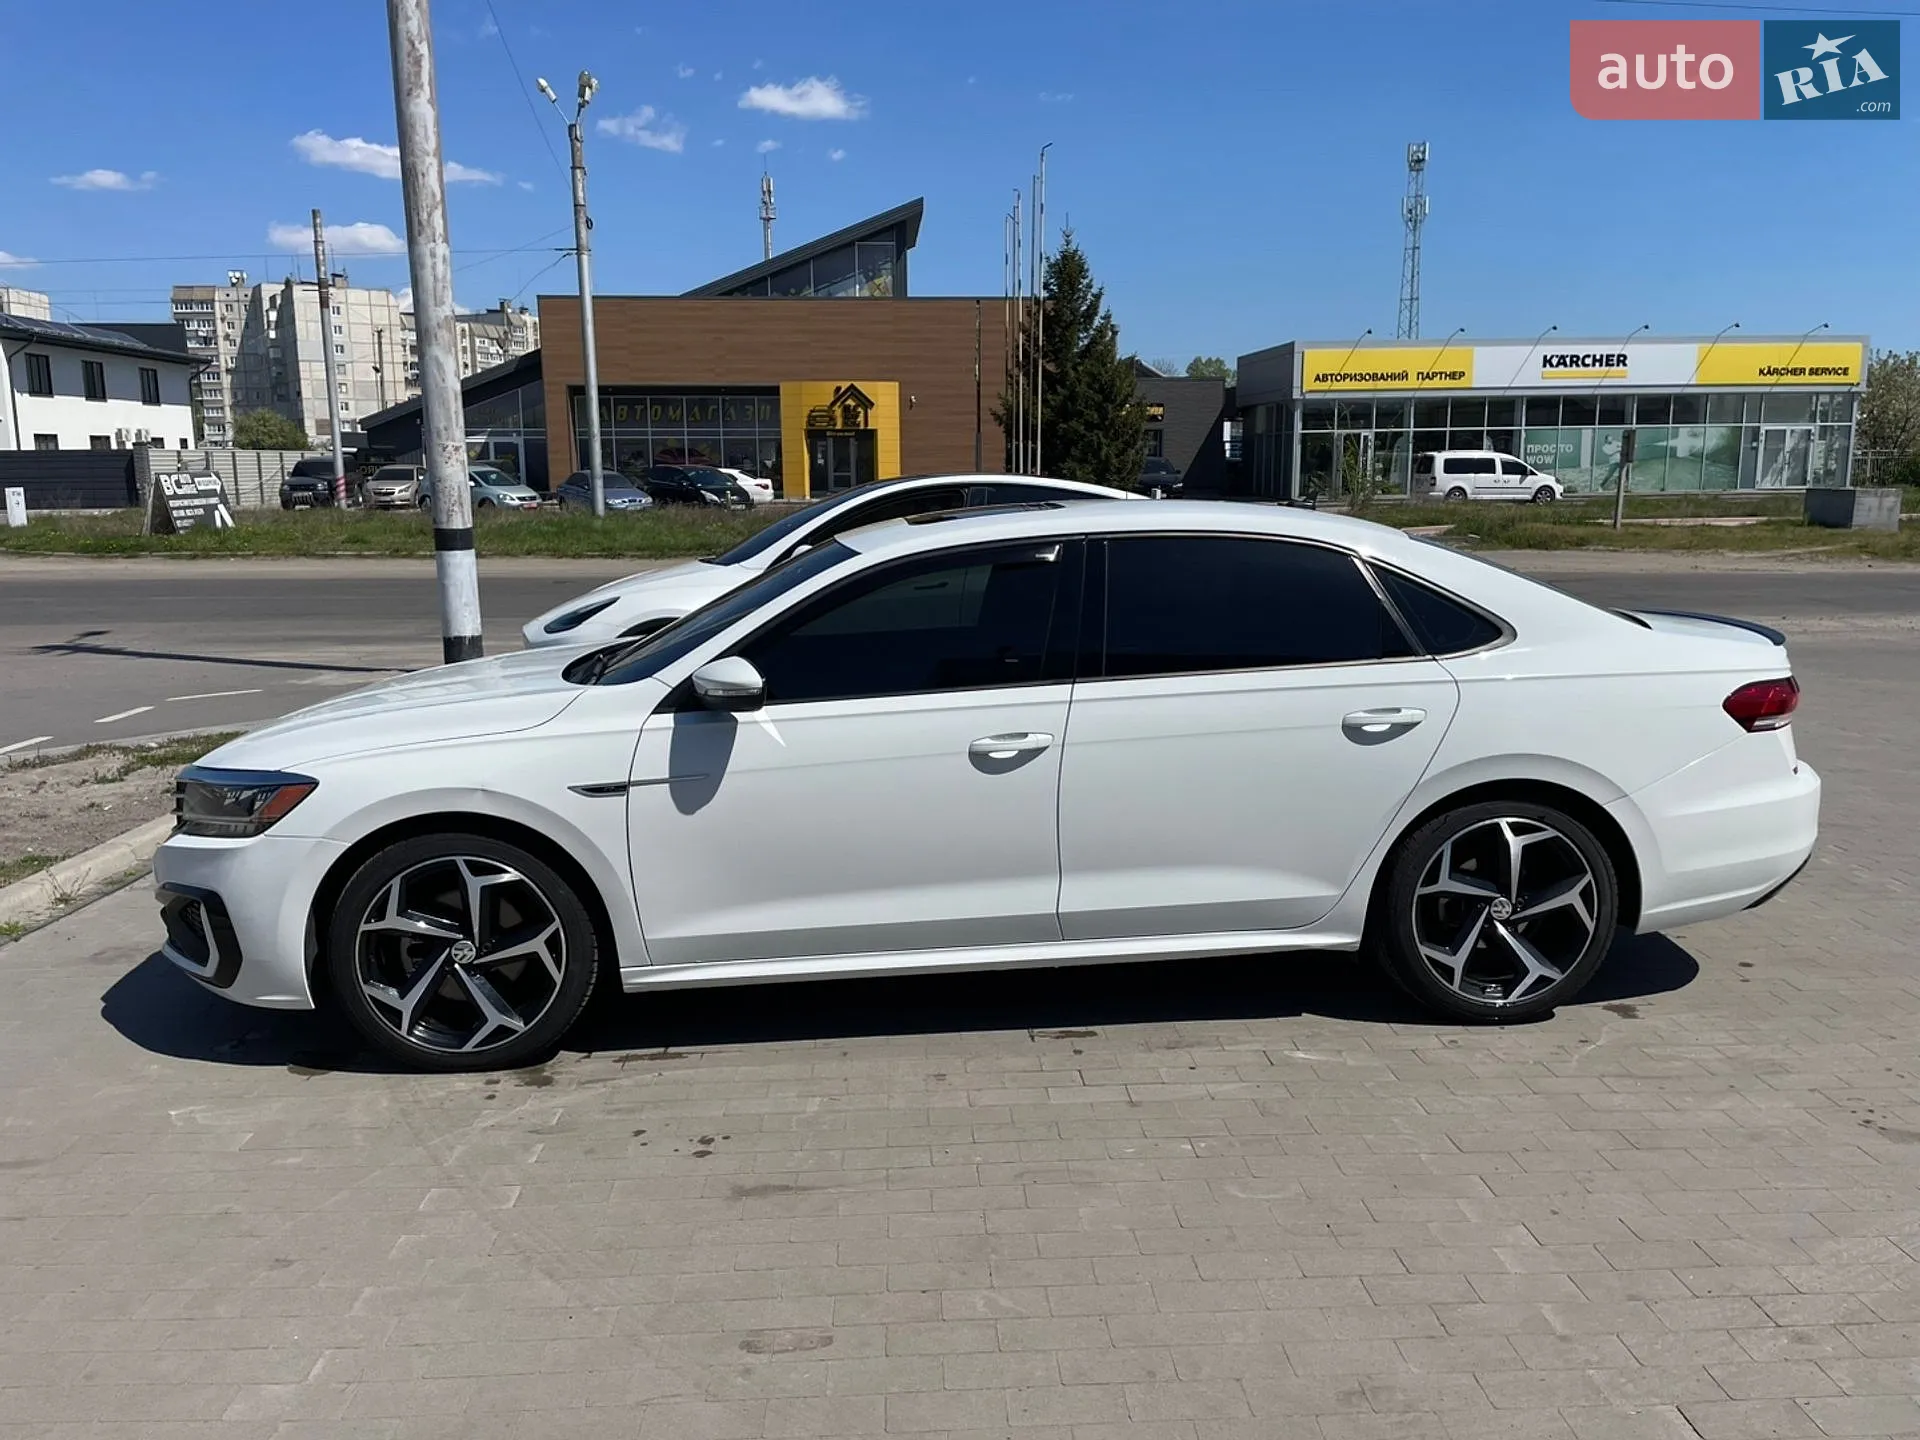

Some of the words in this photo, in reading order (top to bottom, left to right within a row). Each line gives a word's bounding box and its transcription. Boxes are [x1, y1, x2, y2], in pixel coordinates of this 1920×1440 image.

[1542, 353, 1628, 368] KÄRCHER
[1313, 371, 1409, 383] АВТОРИЗОВАНИЙ
[1416, 371, 1466, 381] ПАРТНЕР
[1758, 365, 1807, 377] KÄRCHER
[1808, 366, 1850, 377] SERVICE
[1526, 443, 1574, 454] ПРОСТО
[1526, 455, 1555, 465] WOW
